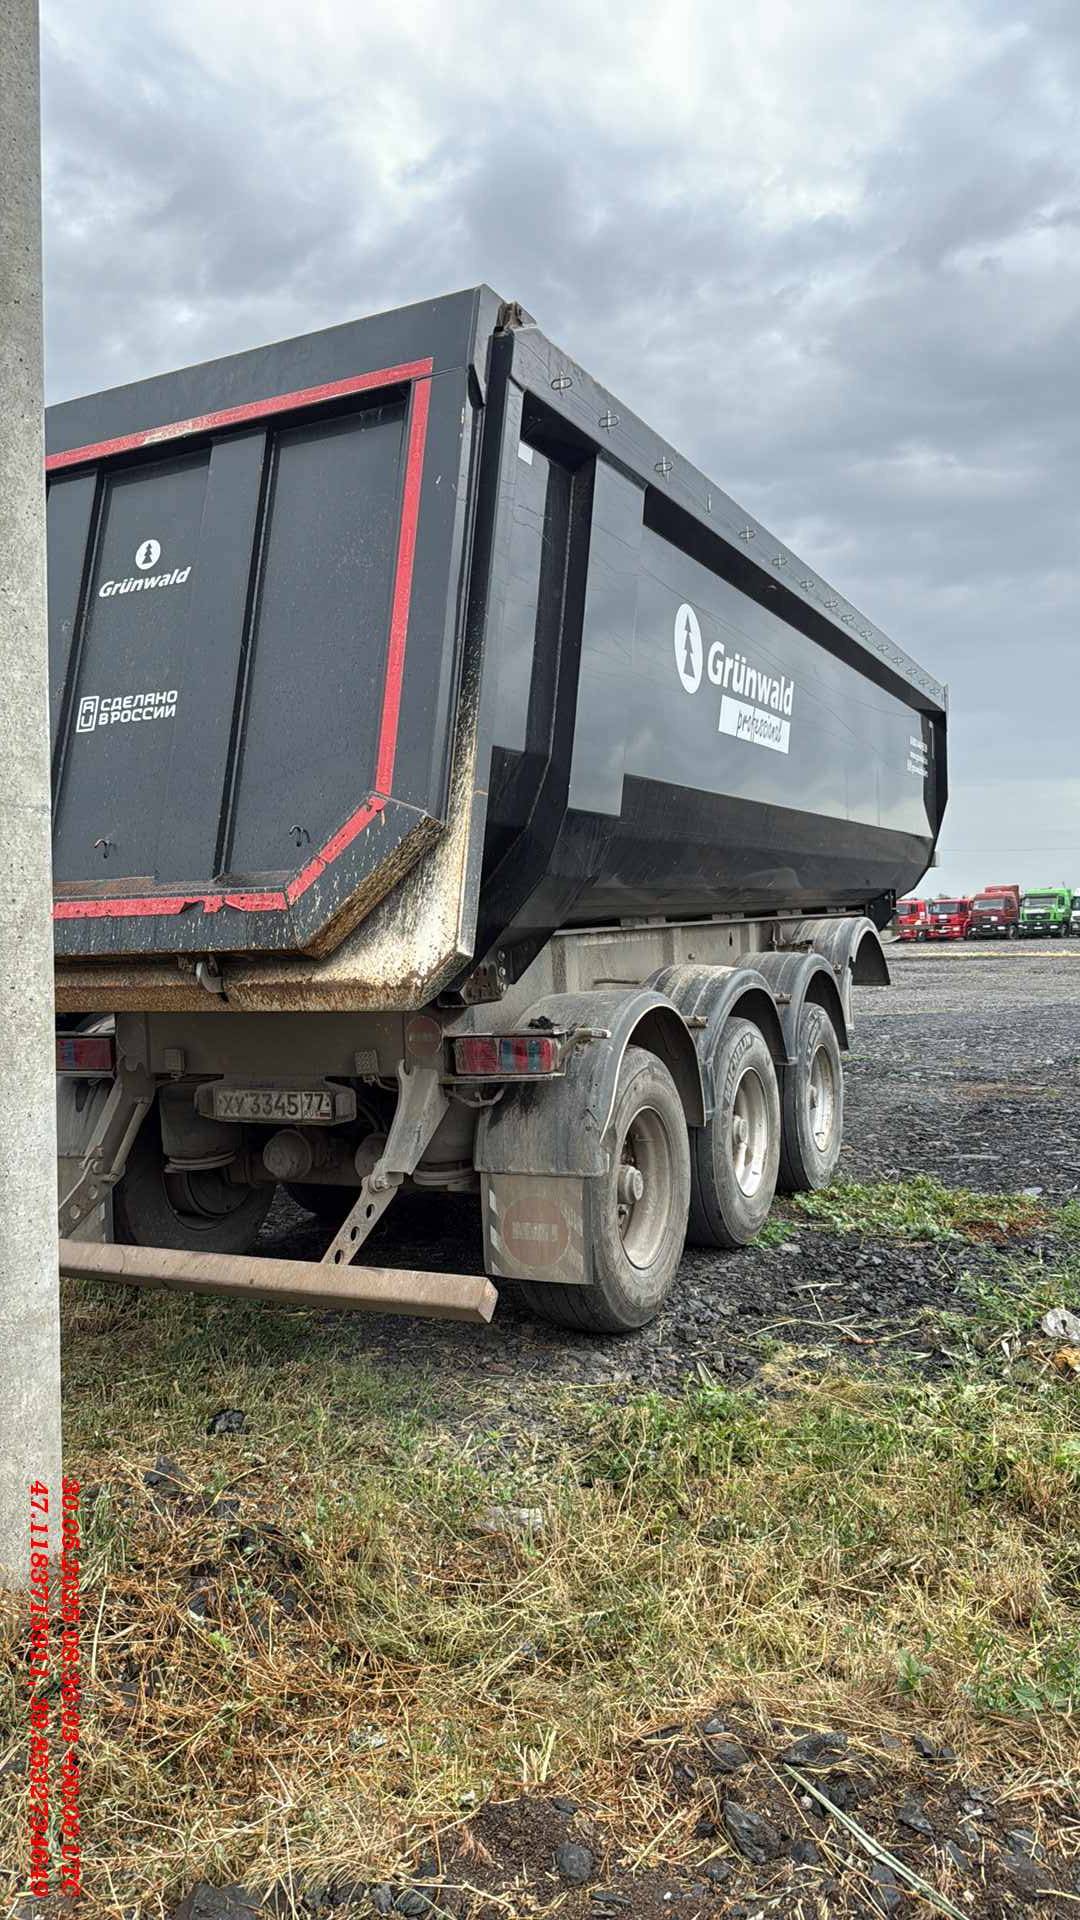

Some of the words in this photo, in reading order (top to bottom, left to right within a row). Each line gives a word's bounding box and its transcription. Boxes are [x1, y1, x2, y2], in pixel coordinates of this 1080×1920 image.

[99, 567, 191, 597] Grünwald
[708, 641, 794, 716] Grünwald
[101, 690, 178, 711] СДЕЛАНО
[735, 706, 783, 743] professional
